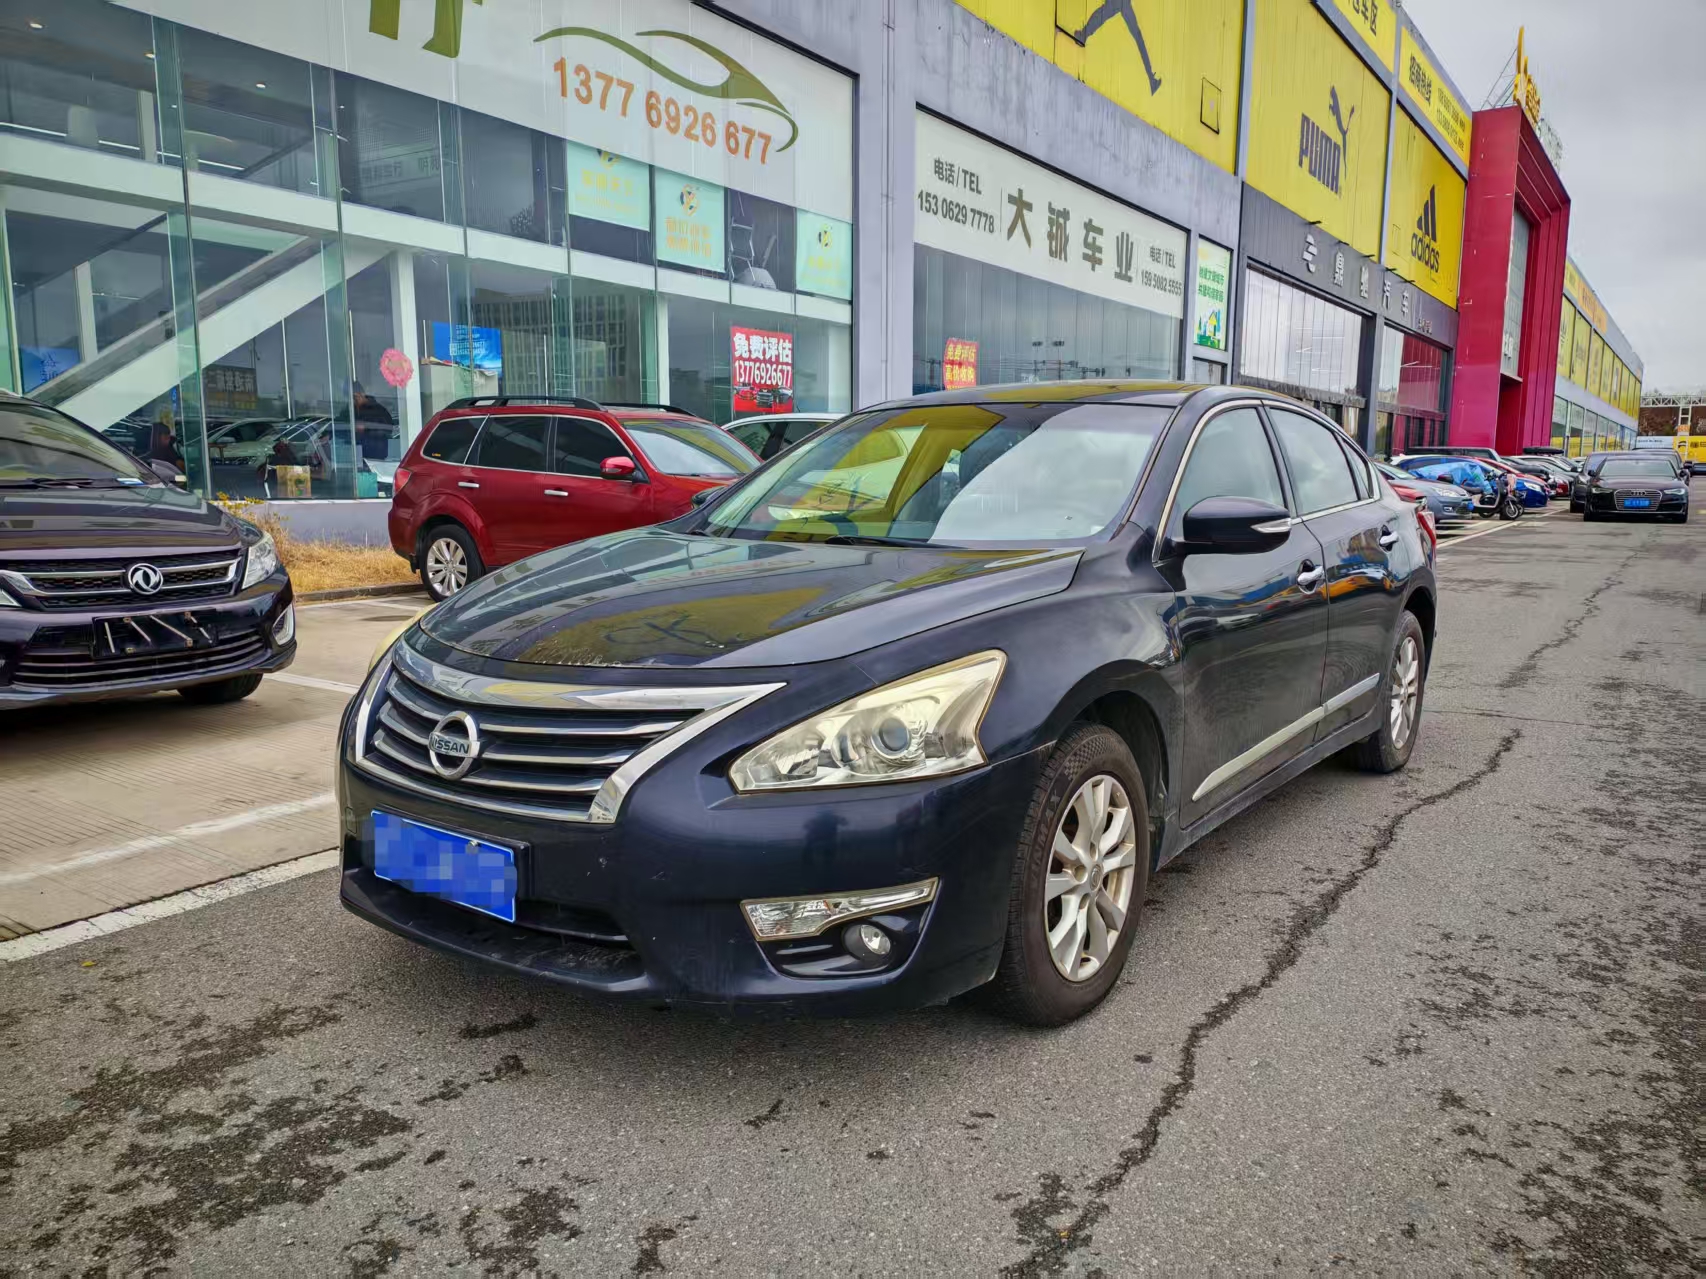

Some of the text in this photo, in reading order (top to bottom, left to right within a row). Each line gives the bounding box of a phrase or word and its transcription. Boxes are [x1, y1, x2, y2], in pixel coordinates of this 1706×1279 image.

[552, 56, 772, 165] 1377 6926 677
[1299, 113, 1341, 195] PUMA
[918, 189, 995, 234] 153 0629 7778
[1411, 232, 1440, 273] adidas
[1141, 269, 1152, 287] 159
[733, 332, 793, 364] 免费评估
[946, 343, 977, 363] 免费评估
[735, 359, 792, 388] 13776926677
[432, 734, 470, 755] NISSAN
